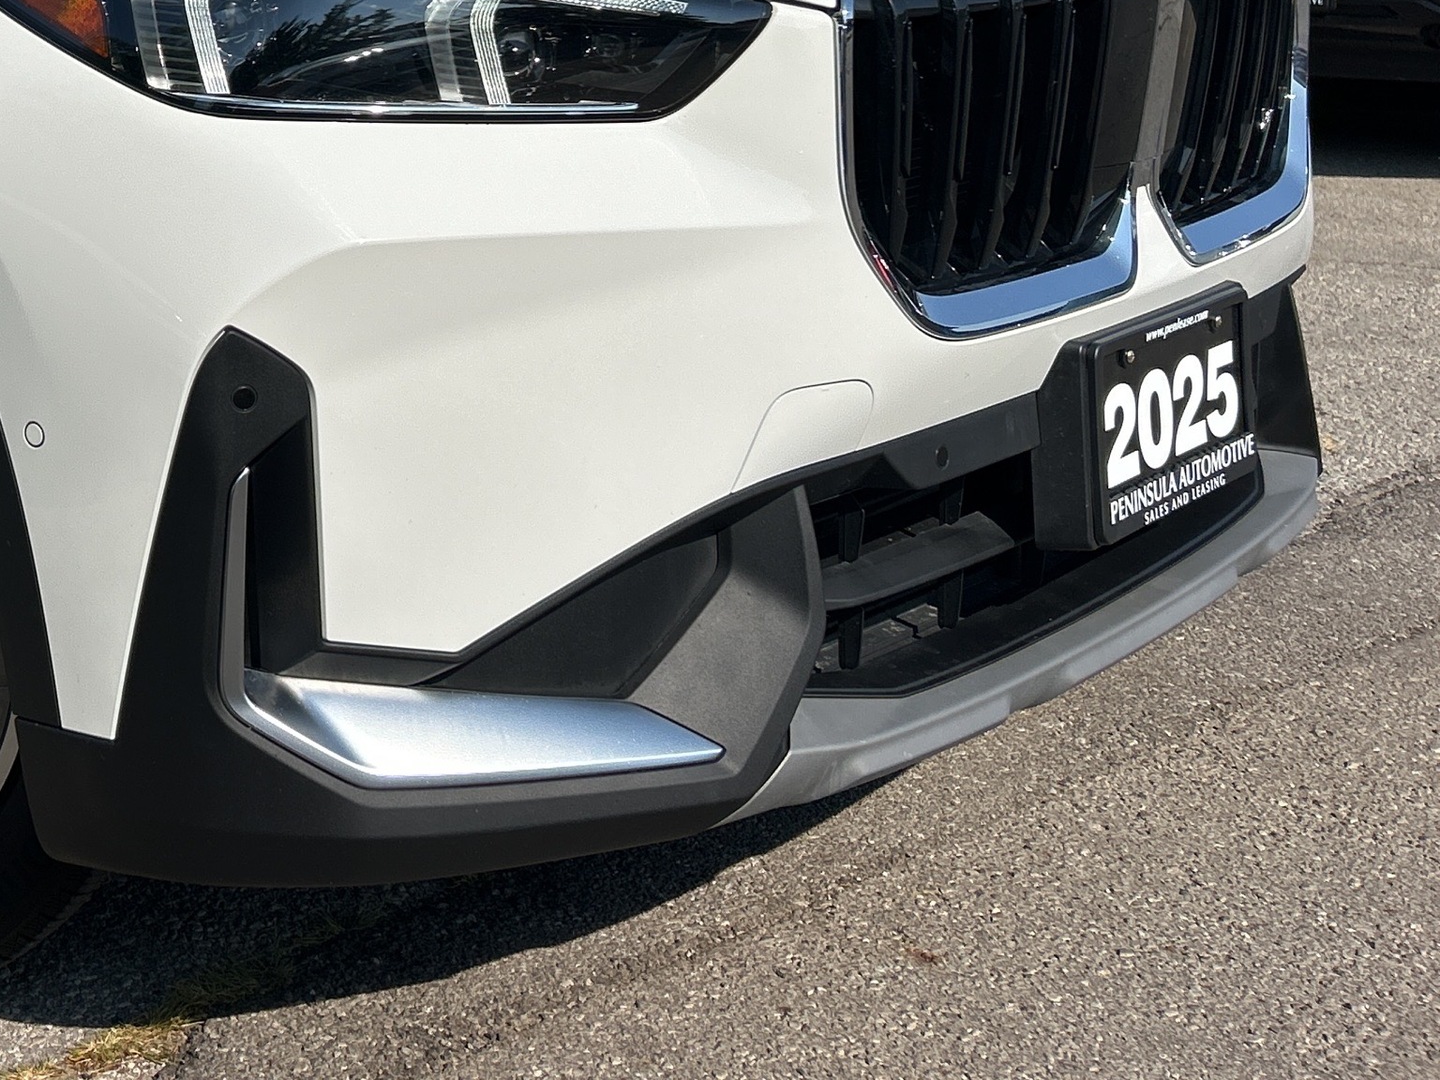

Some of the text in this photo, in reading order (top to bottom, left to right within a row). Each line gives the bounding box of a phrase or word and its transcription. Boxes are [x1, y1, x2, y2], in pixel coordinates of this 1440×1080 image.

[1103, 340, 1240, 490] 2025
[1110, 433, 1257, 525] PENINSULA AUTOMOTIVE
[1144, 472, 1227, 526] SALES AND LEASING
